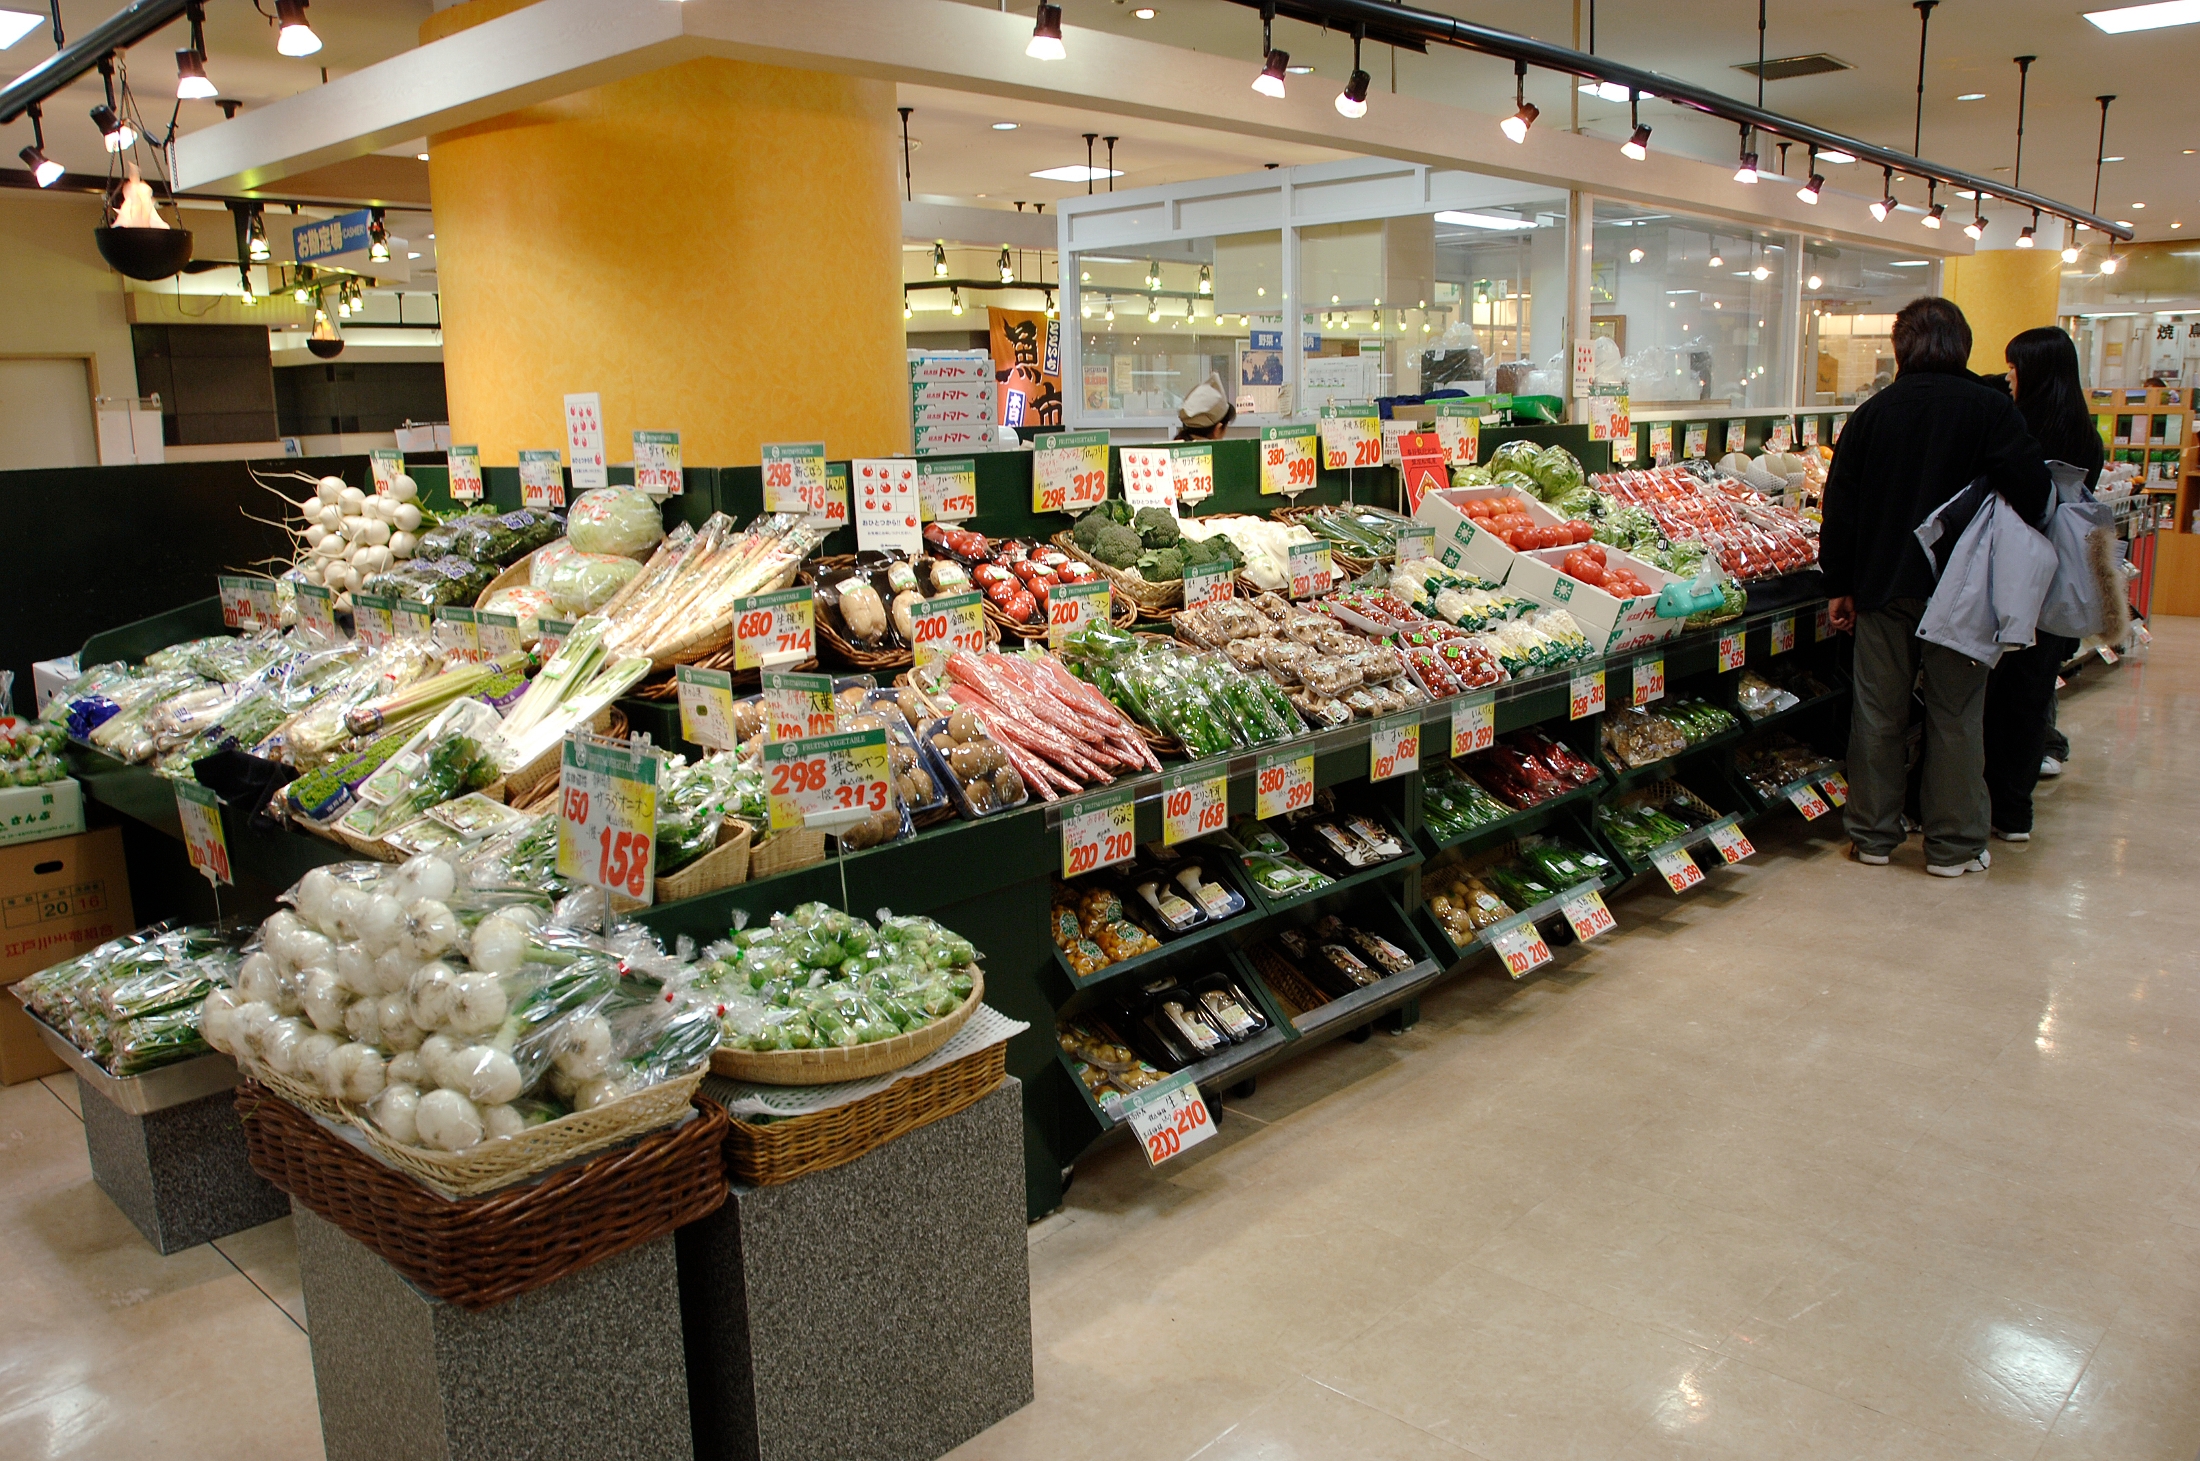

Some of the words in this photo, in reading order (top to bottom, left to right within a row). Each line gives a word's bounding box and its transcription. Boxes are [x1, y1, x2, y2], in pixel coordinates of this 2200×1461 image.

[297, 222, 343, 259] お勘定場
[2157, 324, 2174, 340] 焼
[1008, 393, 1023, 427] 本日
[1610, 414, 1631, 438] 840
[1328, 451, 1348, 467] 200
[1355, 438, 1381, 467] 210
[1456, 436, 1477, 462] 313
[660, 469, 681, 492] 525
[1267, 448, 1285, 466] 380
[1287, 457, 1316, 486] 399
[546, 484, 565, 506] 210
[766, 463, 792, 488] 298
[797, 484, 825, 509] 313
[1041, 486, 1067, 510] 298
[1069, 469, 1107, 503] 313
[1193, 475, 1212, 493] 313
[943, 494, 975, 515] 1575
[1209, 582, 1233, 603] 313
[1293, 575, 1310, 597] 380
[1313, 570, 1331, 592] 399
[238, 599, 251, 618] 210
[1051, 600, 1079, 626] 200
[737, 610, 773, 641] 680
[777, 628, 812, 654] 714
[915, 615, 948, 644] 200
[951, 629, 983, 654] 210
[1720, 639, 1732, 657] 500
[1730, 650, 1744, 668] 525
[809, 690, 834, 713] 大葉
[1572, 695, 1588, 719] 298
[1590, 684, 1604, 705] 313
[1635, 685, 1649, 704] 200
[1650, 675, 1663, 694] 210
[777, 723, 803, 740] 100
[807, 713, 836, 737] 105
[1455, 730, 1473, 754] 380
[1475, 725, 1493, 749] 399
[803, 735, 867, 752] FRUITS&VEGETABLE
[1373, 755, 1395, 779] 160
[1396, 737, 1418, 761] 168
[771, 759, 827, 797] 298
[832, 781, 889, 812] 313
[1258, 767, 1285, 795] 380
[1286, 781, 1313, 810] 399
[595, 792, 653, 818] サラダオニオン
[1166, 790, 1192, 819] 160
[1197, 802, 1225, 833] 168
[562, 786, 589, 825] 150
[599, 825, 650, 898] 158
[1068, 843, 1099, 874] 200
[1104, 831, 1133, 862] 210
[1722, 845, 1739, 864] 298
[1737, 838, 1752, 856] 313
[1668, 873, 1687, 891] 380
[1683, 864, 1701, 883] 399
[44, 900, 68, 918] 20
[1575, 919, 1596, 942] 298
[1591, 908, 1612, 931] 313
[1507, 952, 1529, 974] 200
[1527, 940, 1549, 964] 210
[1148, 1127, 1181, 1164] 200
[1173, 1100, 1207, 1136] 210
